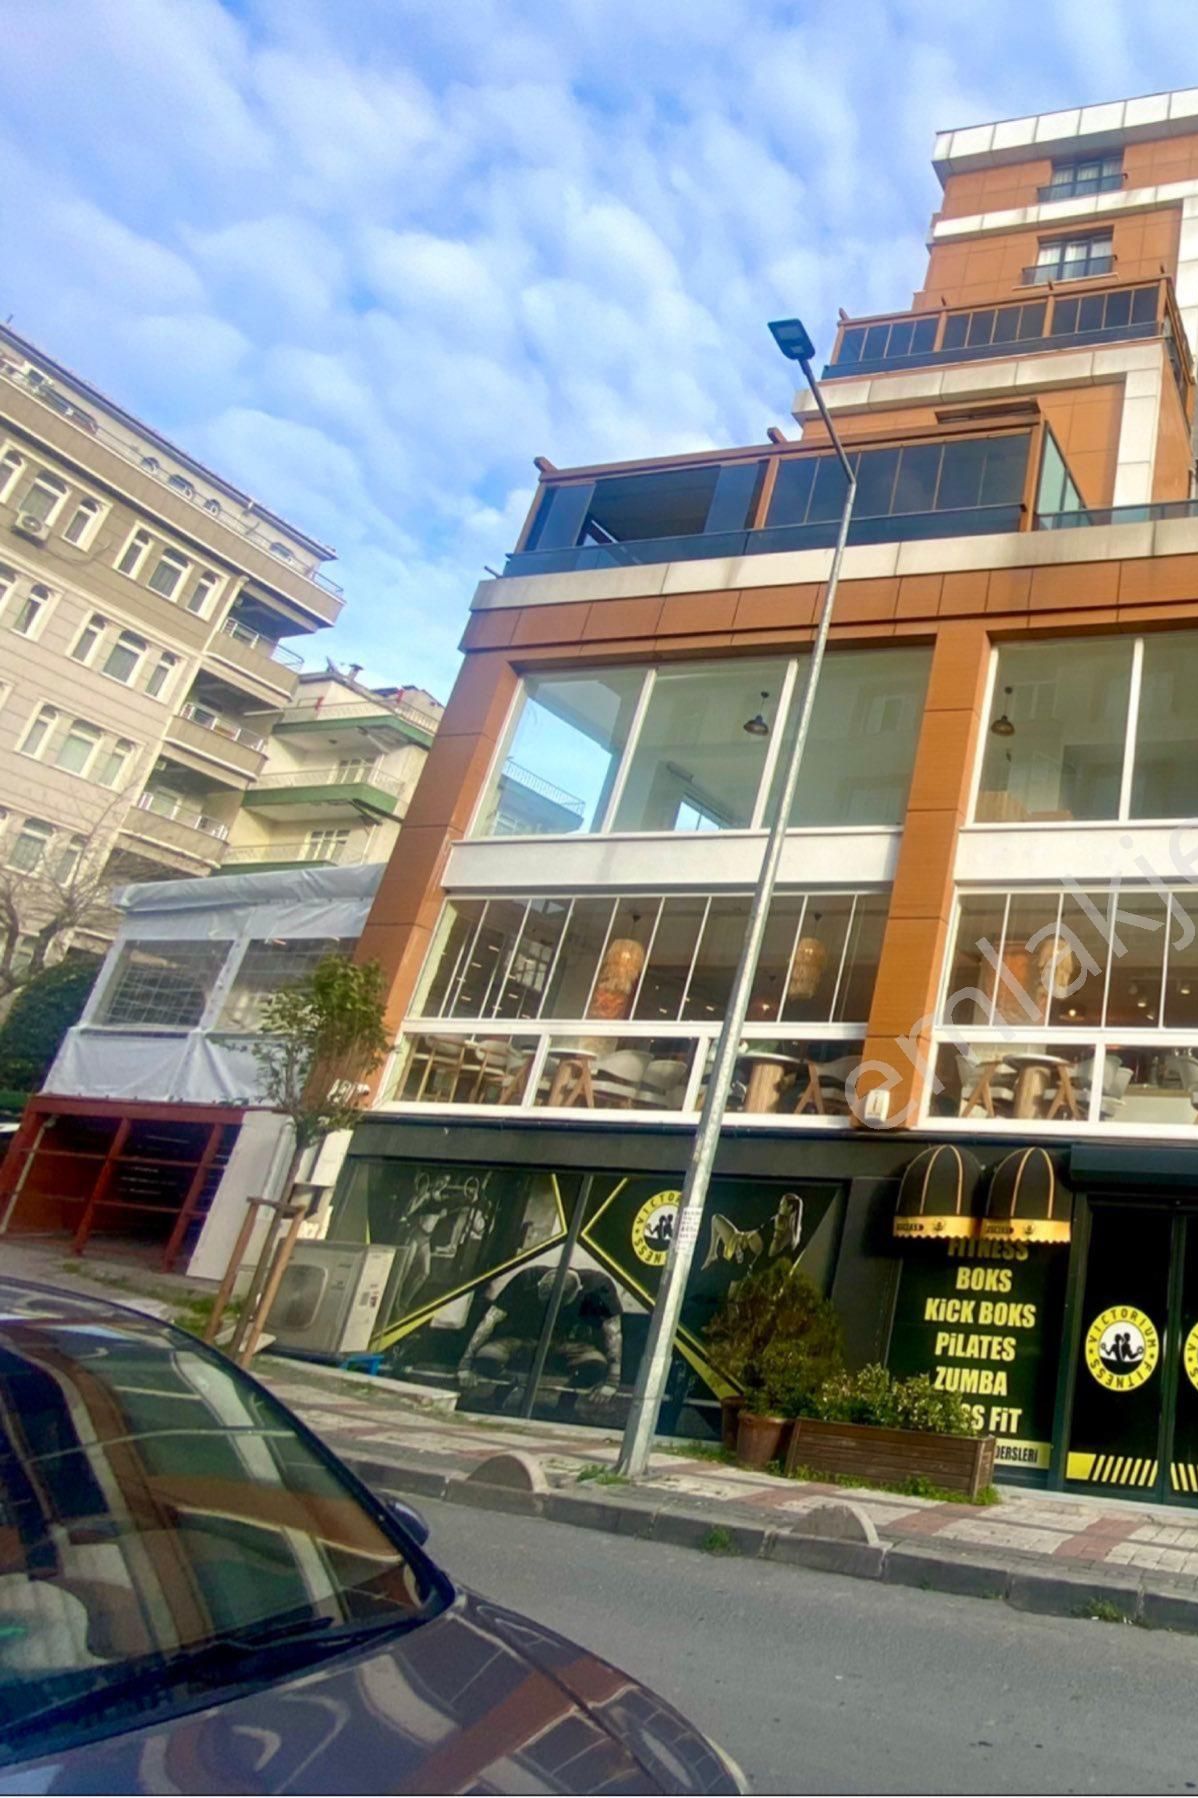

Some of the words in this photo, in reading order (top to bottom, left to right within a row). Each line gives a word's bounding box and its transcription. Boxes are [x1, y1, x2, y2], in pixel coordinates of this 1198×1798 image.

[947, 1238, 1029, 1261] FITNESS
[955, 1266, 1013, 1293] BOKS
[978, 1301, 1037, 1328] BOKS
[1088, 1308, 1157, 1347] VICTORIUM
[934, 1366, 1008, 1396] ZUMBA
[1089, 1359, 1153, 1388] FITNESS
